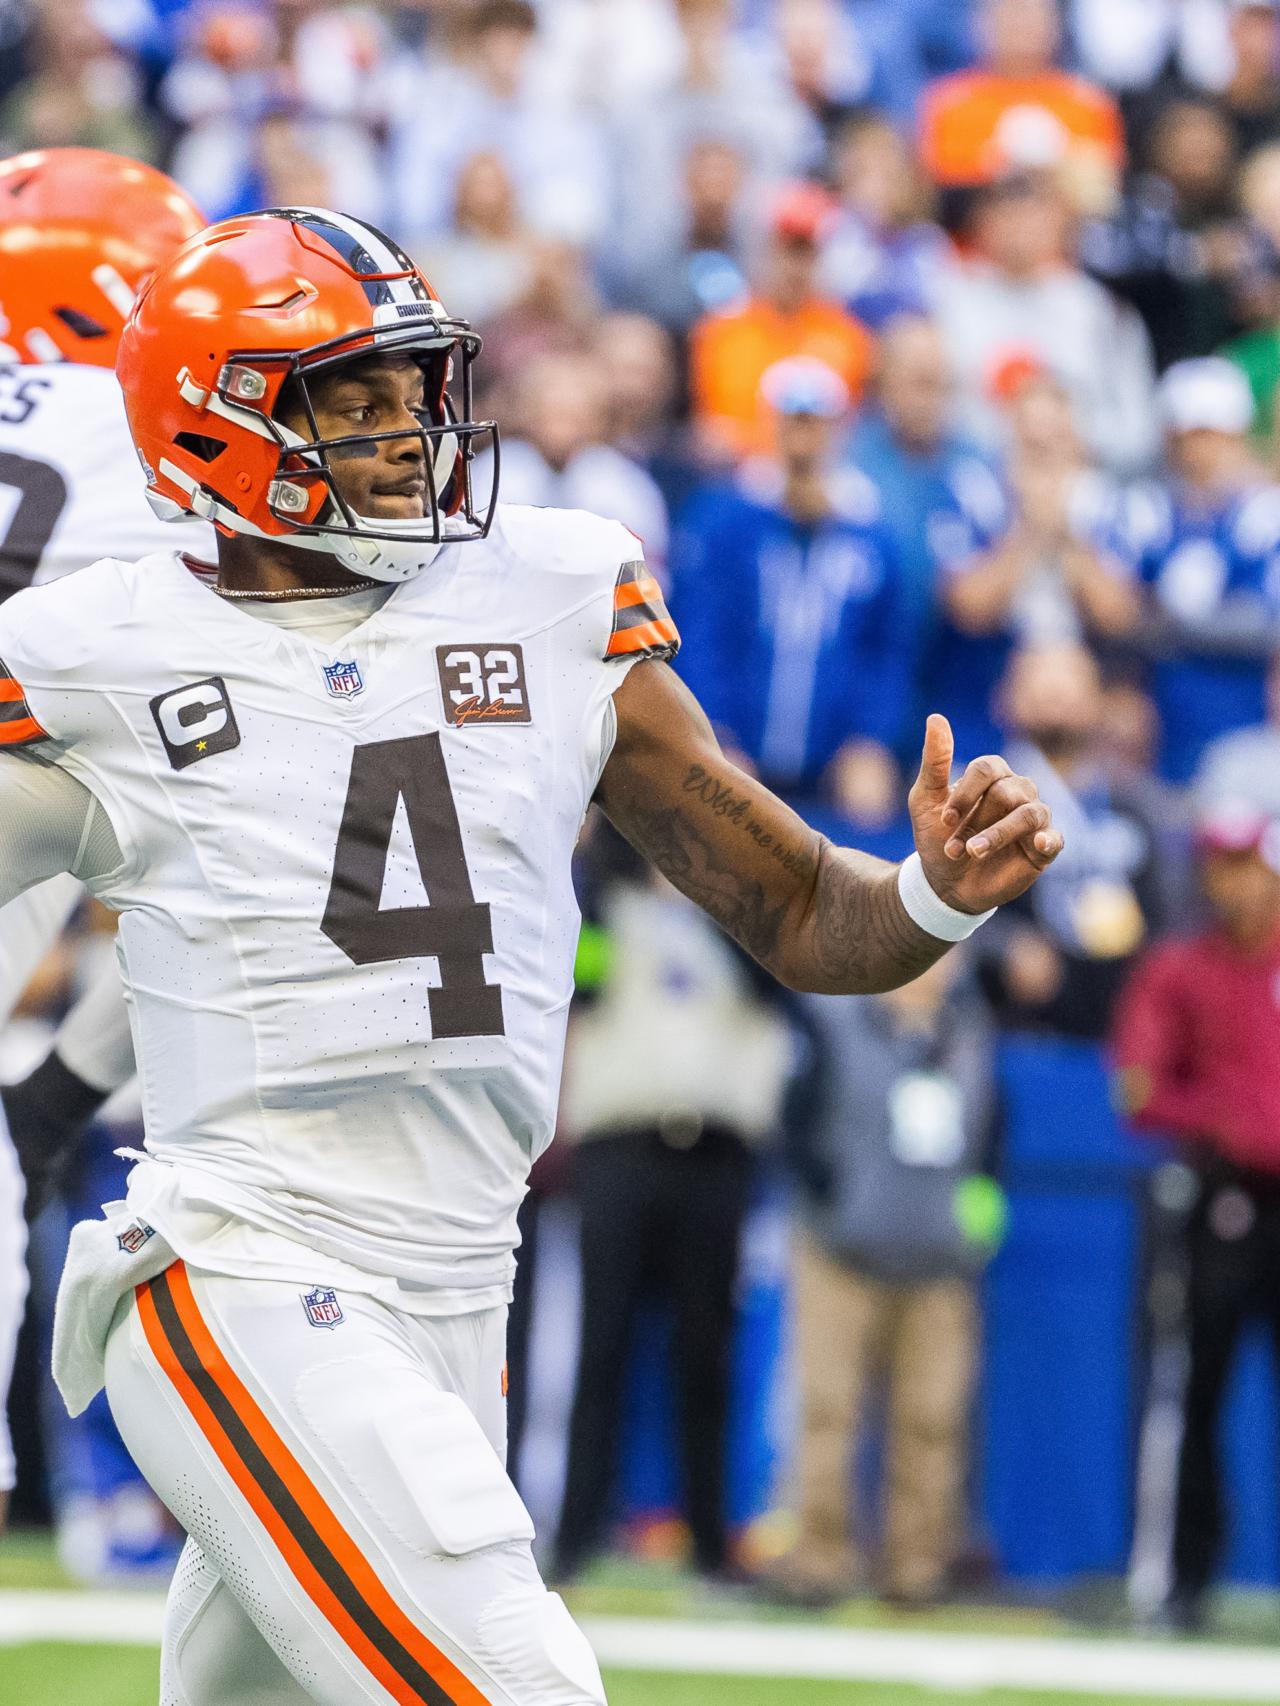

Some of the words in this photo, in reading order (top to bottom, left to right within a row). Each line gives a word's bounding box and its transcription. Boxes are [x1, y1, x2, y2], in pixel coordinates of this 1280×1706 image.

[331, 675, 360, 692] NFL
[444, 650, 523, 706] 32
[158, 685, 228, 747] C
[682, 763, 751, 825] Wish
[744, 820, 773, 847] me
[320, 731, 505, 1039] 4
[312, 1304, 340, 1320] NFL
